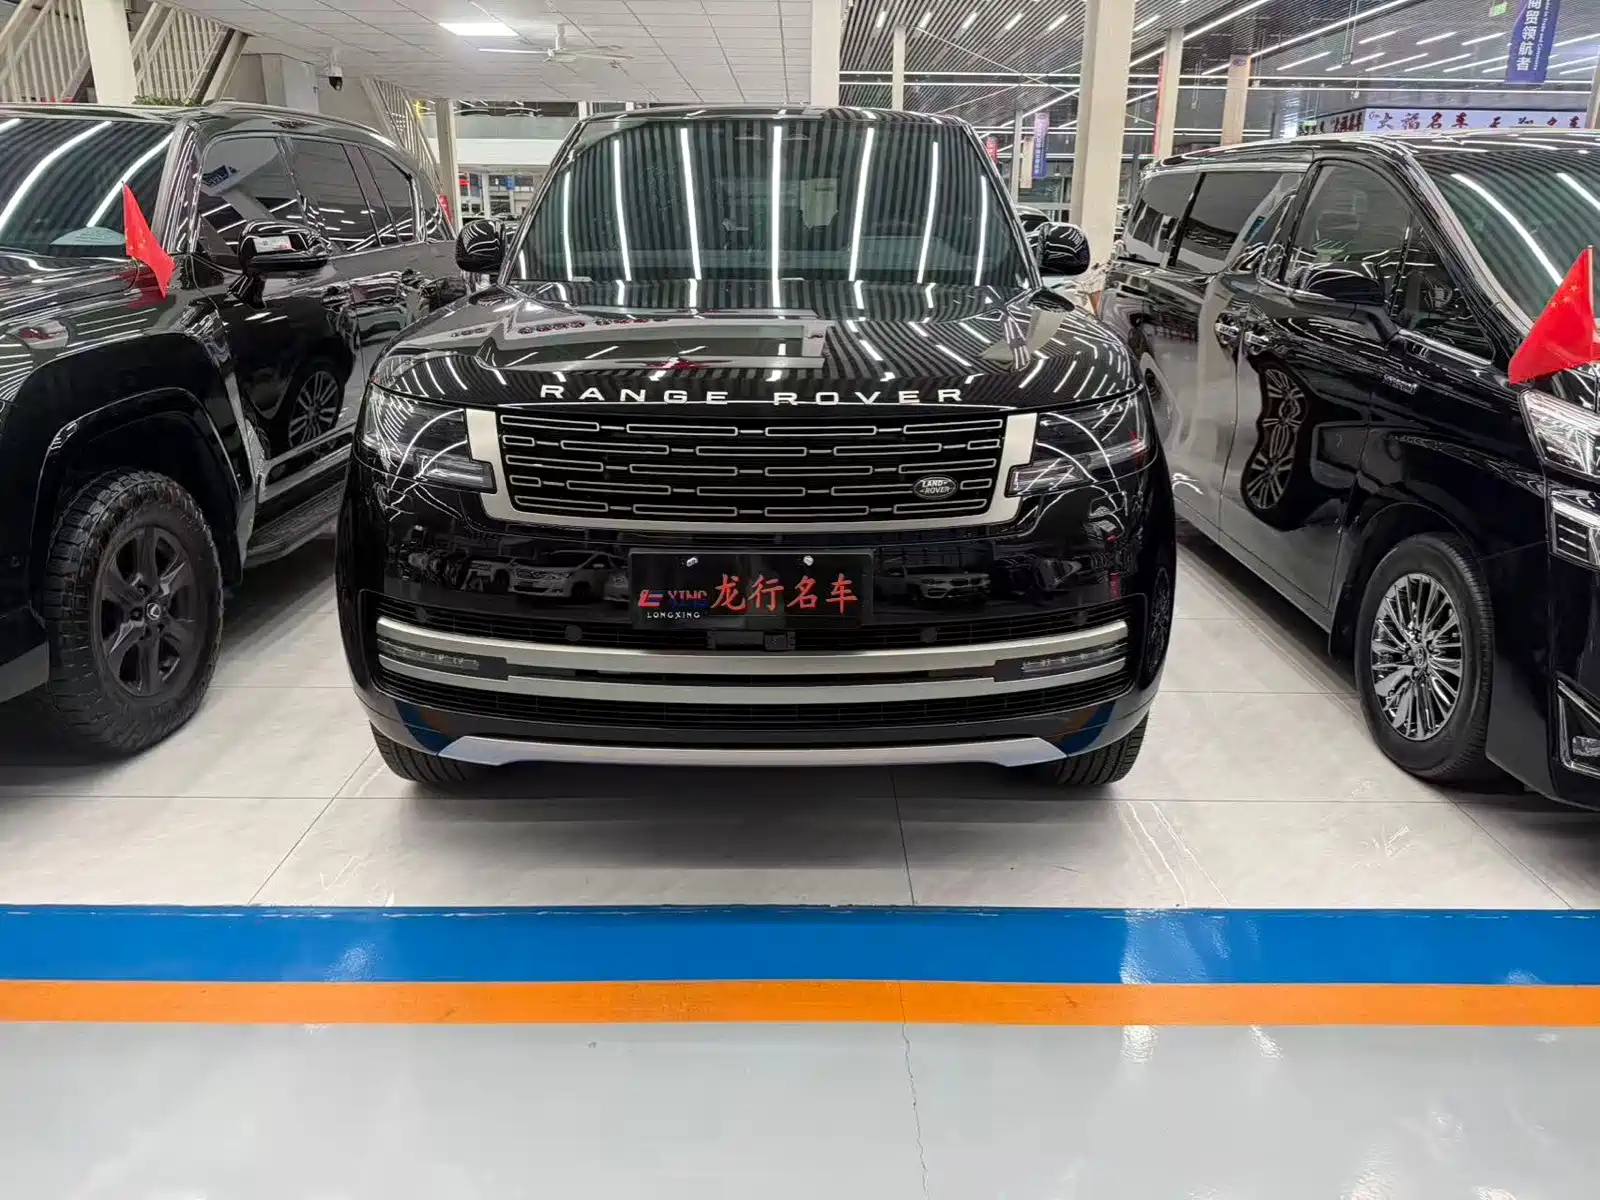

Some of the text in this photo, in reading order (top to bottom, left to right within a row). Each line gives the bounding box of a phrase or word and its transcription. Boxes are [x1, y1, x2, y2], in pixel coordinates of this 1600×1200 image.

[540, 384, 963, 406] RANGE ROVER
[711, 573, 858, 615] 龙行名车
[646, 611, 701, 619] LONGXING
